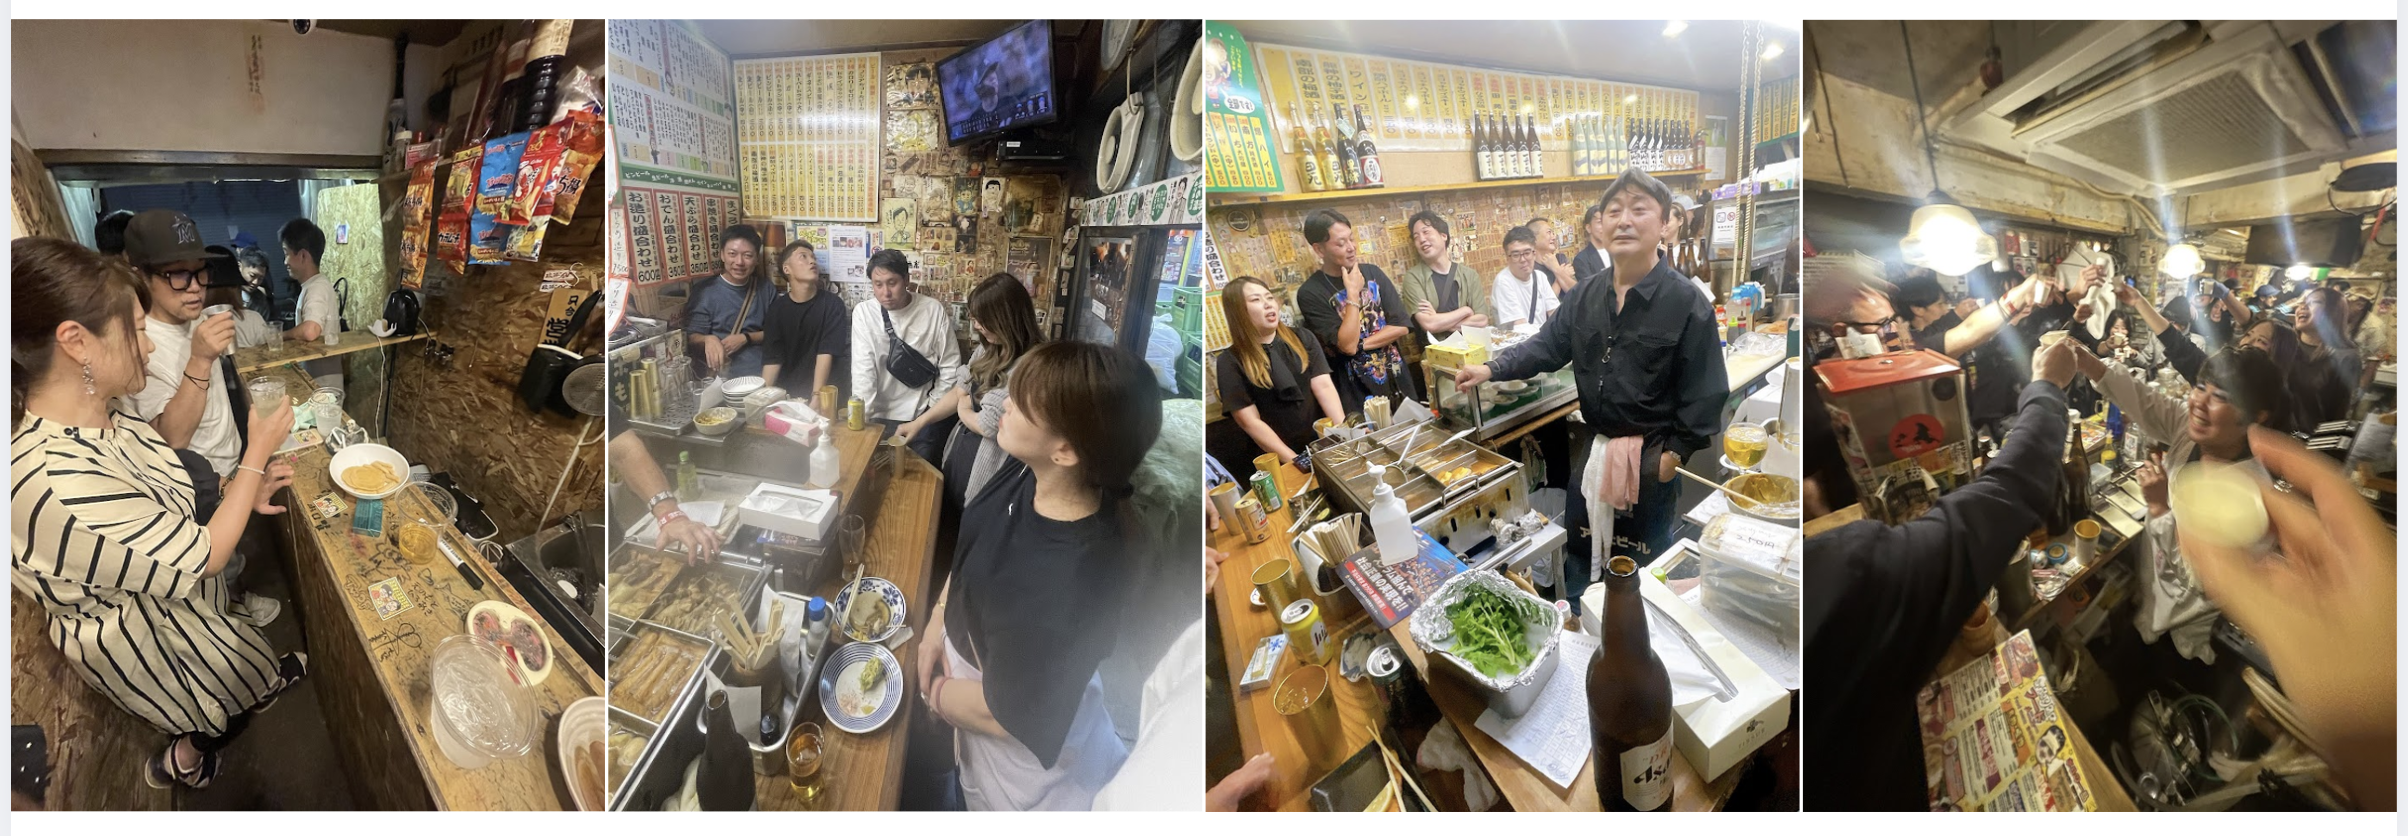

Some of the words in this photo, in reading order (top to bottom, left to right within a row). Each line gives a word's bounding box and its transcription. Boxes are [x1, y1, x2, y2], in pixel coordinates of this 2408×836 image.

[628, 192, 653, 268] お造り盛合わせ
[659, 194, 679, 264] おでん盛合わせ
[684, 196, 702, 261] 天ぷら盛合わせ
